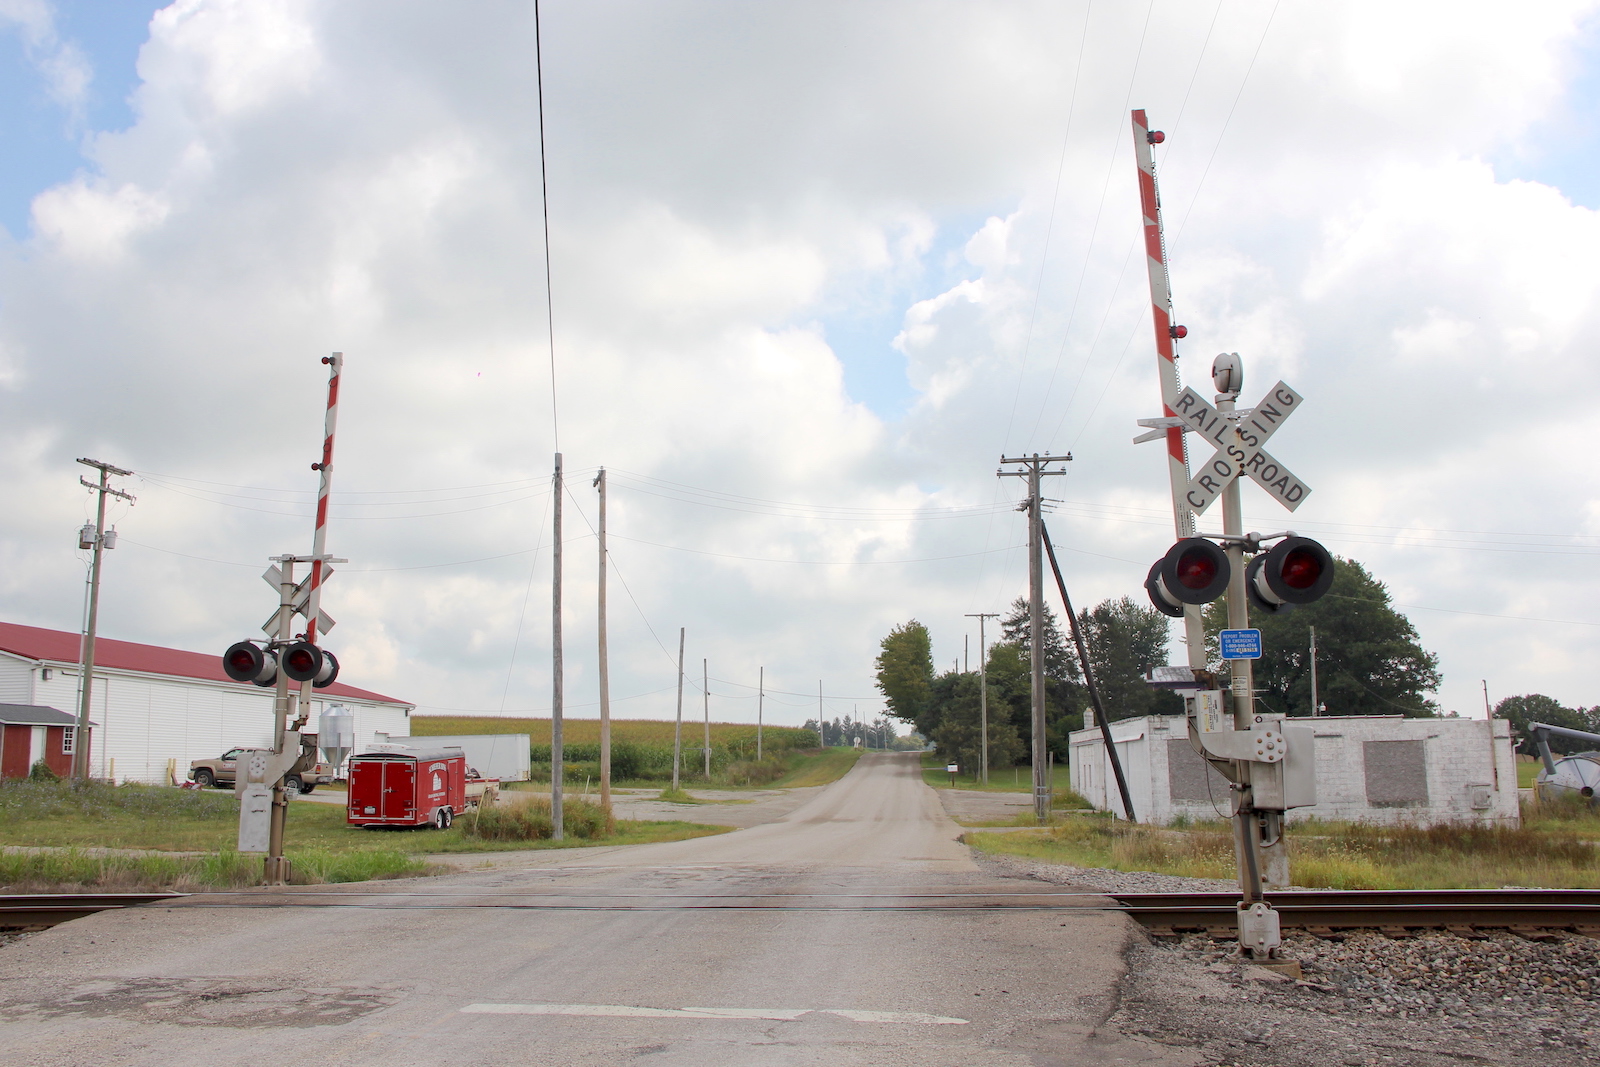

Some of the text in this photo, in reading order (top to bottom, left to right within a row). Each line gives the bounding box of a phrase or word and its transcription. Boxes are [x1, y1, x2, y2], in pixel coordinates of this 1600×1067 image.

[1176, 393, 1303, 503] RAIL ROAD
[1186, 389, 1294, 508] CROSSING
